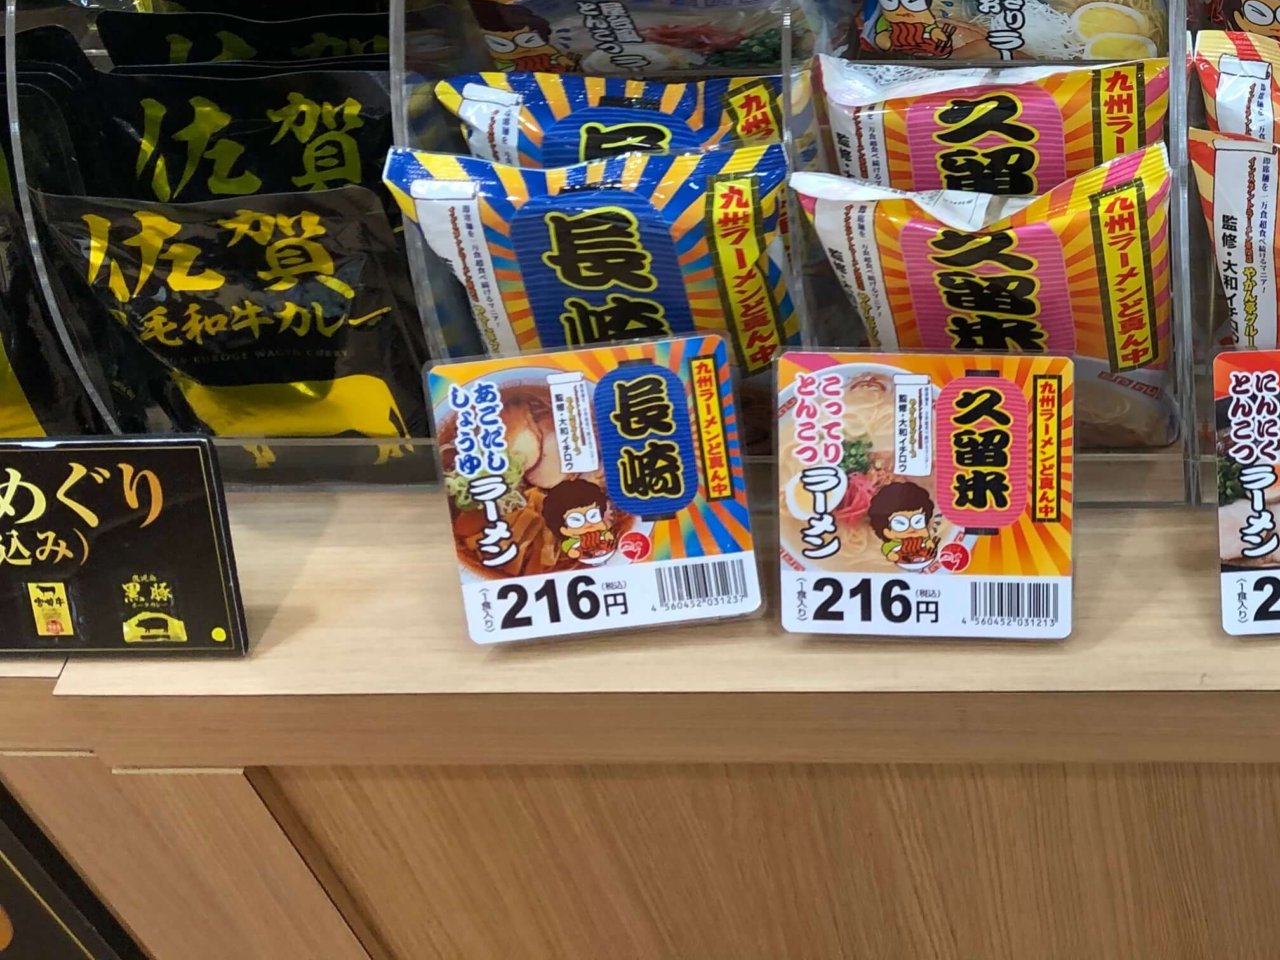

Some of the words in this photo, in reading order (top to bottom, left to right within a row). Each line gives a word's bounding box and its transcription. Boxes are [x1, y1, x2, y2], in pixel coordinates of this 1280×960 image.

[134, 92, 364, 203] 佐賀
[1103, 70, 1134, 154] 九州ラー
[82, 209, 355, 303] 佐賀
[543, 207, 671, 349] 長崎
[929, 229, 1048, 353] 久留米
[1103, 195, 1151, 364] 九州ラーメンど真ん中
[449, 386, 481, 475] しょうゆ
[474, 383, 506, 472] あごだし
[613, 376, 683, 498] 長崎
[694, 361, 729, 496] 九州ラーメンど真ん中
[795, 375, 819, 464] とんこつ
[821, 375, 843, 465] こってり
[953, 389, 1010, 509] 久留米
[1038, 381, 1055, 518] 九州ラーメンど真ん中
[1229, 372, 1255, 463] とんこつ
[1255, 372, 1280, 462] にんにく
[0, 462, 163, 529] めぐり
[470, 477, 518, 567] ラーメン
[801, 465, 842, 559] ラーメン
[1239, 464, 1280, 558] ラーメン
